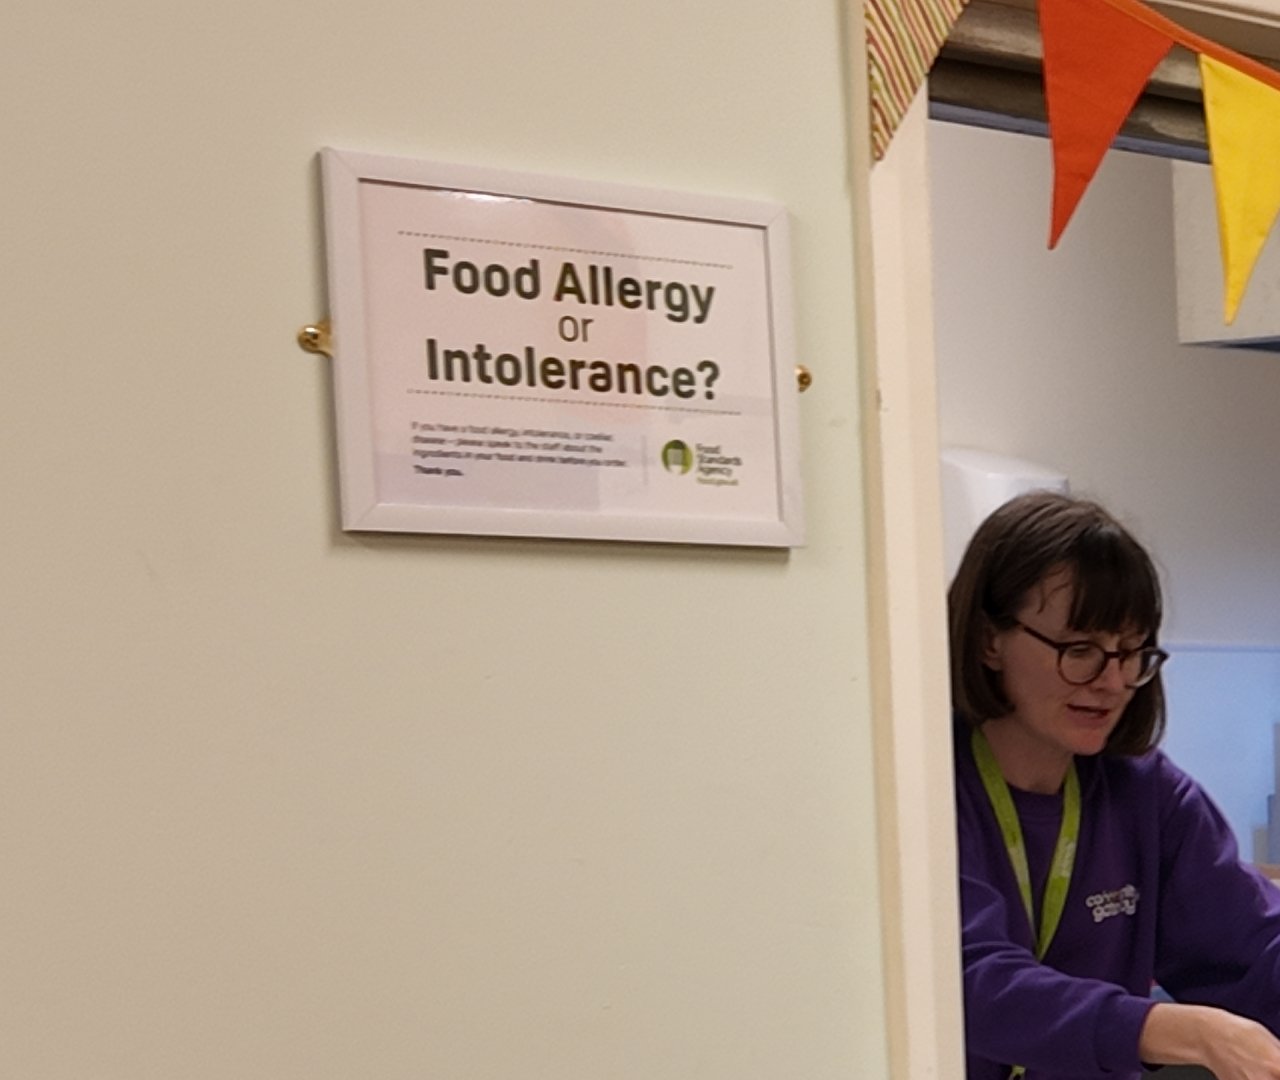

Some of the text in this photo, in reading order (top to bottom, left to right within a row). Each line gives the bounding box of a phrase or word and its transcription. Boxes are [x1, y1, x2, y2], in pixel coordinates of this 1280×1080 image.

[422, 248, 716, 324] Food Allergy
[557, 314, 595, 343] or
[424, 338, 721, 400] Intolerance?
